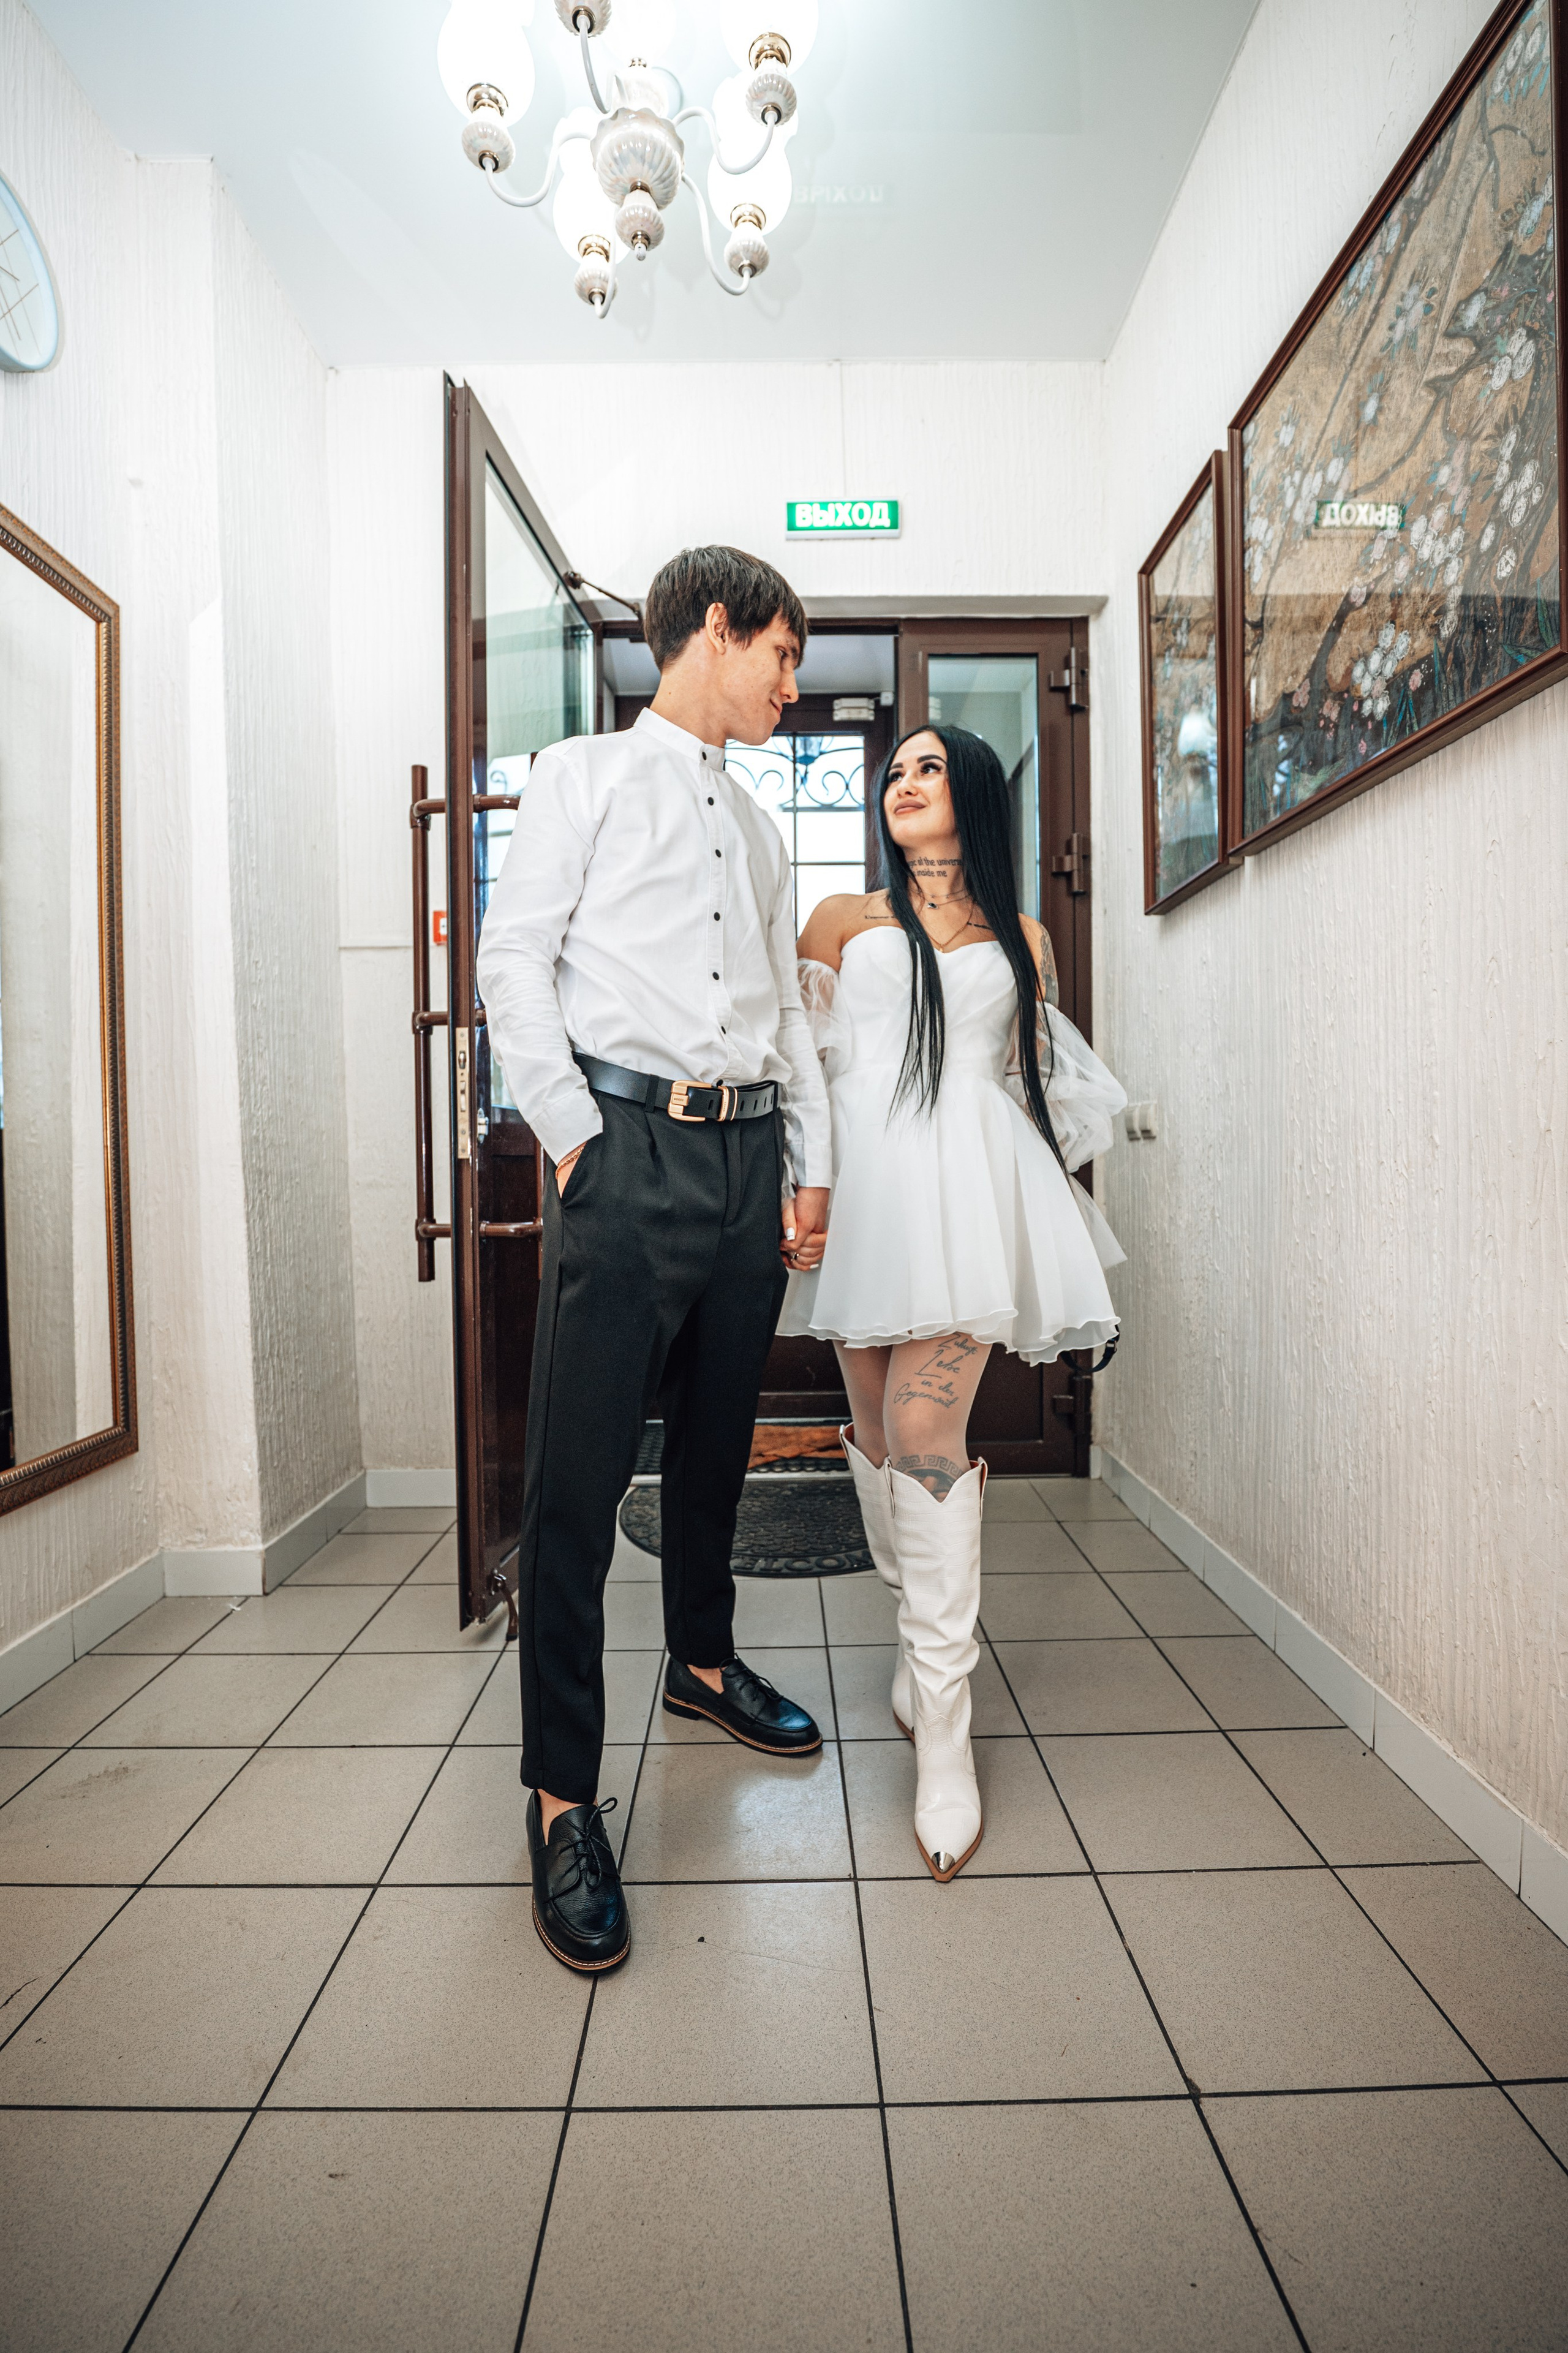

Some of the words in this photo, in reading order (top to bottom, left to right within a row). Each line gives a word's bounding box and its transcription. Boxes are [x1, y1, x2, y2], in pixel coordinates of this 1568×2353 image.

[795, 502, 891, 528] ВЫХОД
[924, 857, 936, 866] the
[917, 869, 935, 877] inside
[894, 1383, 959, 1408] Gegenwart
[938, 1382, 954, 1396] der
[733, 1550, 875, 1573] ELCOM
